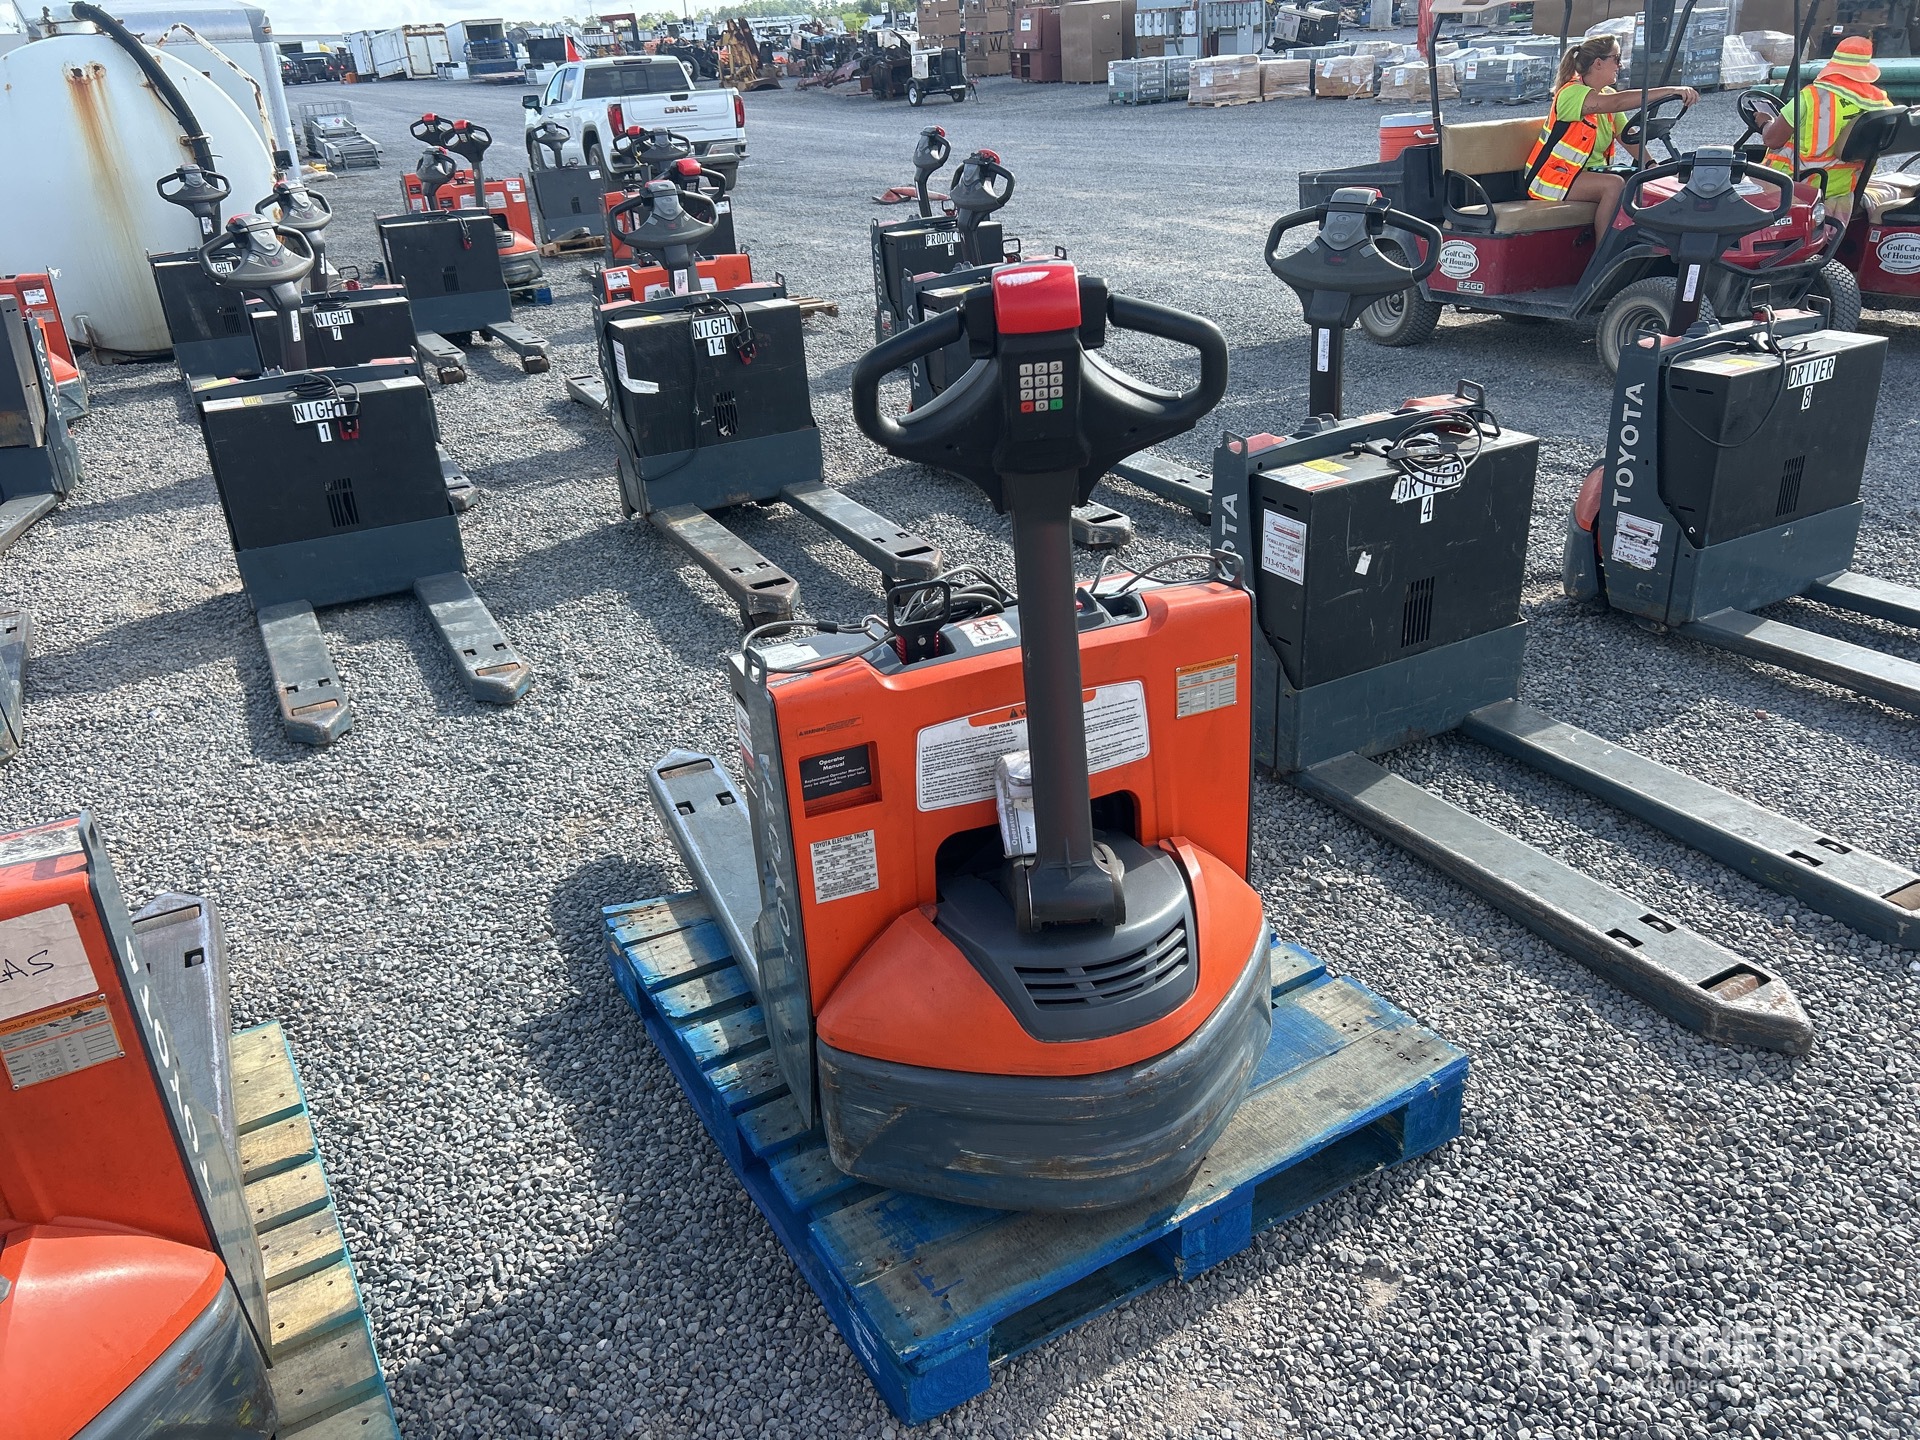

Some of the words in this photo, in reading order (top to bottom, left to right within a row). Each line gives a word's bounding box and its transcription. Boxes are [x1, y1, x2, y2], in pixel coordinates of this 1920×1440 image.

[664, 105, 698, 114] GMC
[1449, 258, 1473, 267] Houston
[1892, 252, 1920, 261] Housto
[873, 243, 883, 306] TOYOTA
[1458, 281, 1483, 290] EZGO
[315, 310, 352, 327] NIGHT
[694, 317, 735, 338] NIGHT
[333, 328, 341, 340] 7
[709, 339, 725, 354] 14
[36, 339, 62, 421] TOYOTA
[1789, 358, 1834, 387] DRIVER
[1803, 387, 1812, 408] 8
[295, 400, 345, 422] NIGH
[321, 425, 329, 441] 1
[1612, 382, 1646, 507] TOYOTA
[1422, 496, 1432, 520] 4
[1264, 556, 1300, 577] 713-675-7000
[819, 755, 845, 766] Operator
[822, 761, 845, 771] Manual
[1007, 806, 1018, 846] Operator's
[813, 841, 832, 849] TOYOTA
[832, 835, 853, 845] ELECTRIC
[854, 831, 869, 840] TRUCK
